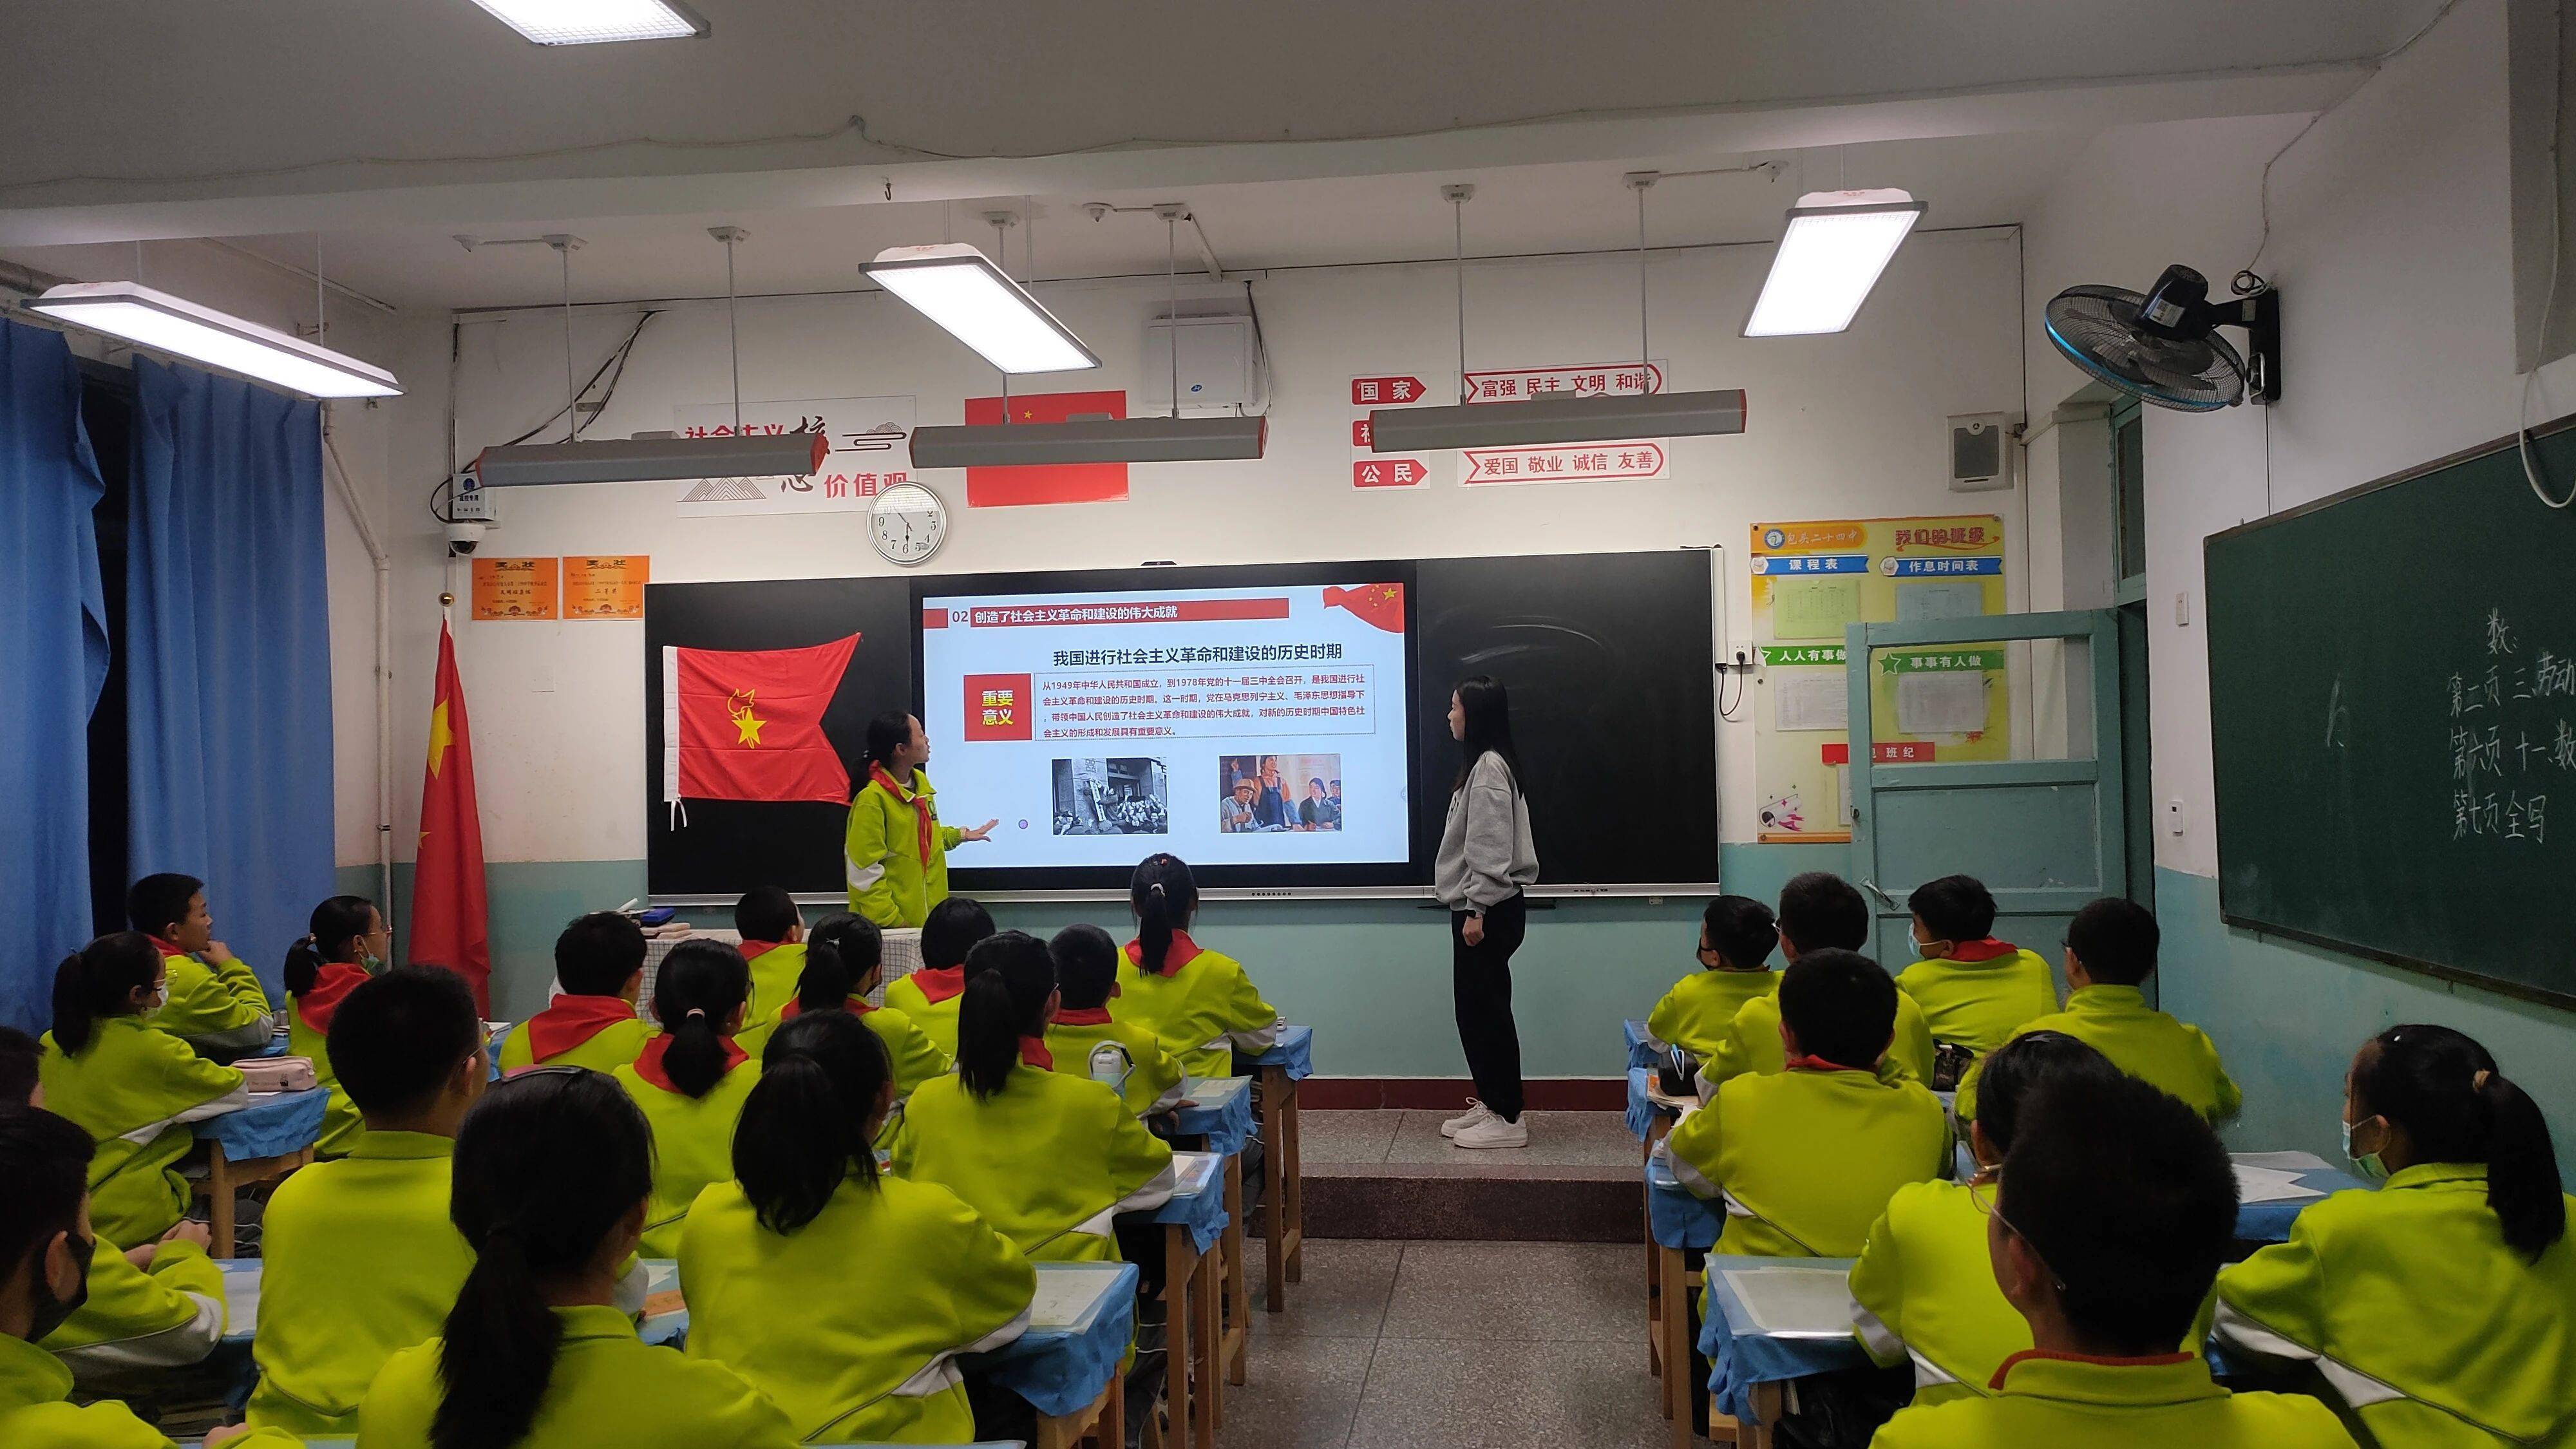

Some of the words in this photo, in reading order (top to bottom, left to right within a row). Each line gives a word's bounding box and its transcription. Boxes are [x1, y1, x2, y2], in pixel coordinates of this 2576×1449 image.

[1361, 381, 1411, 401] 国家
[1481, 379, 1517, 397] 富强
[1526, 377, 1560, 395] 民主
[1571, 374, 1605, 392] 文明
[1484, 457, 1518, 475] 爱国
[1528, 455, 1563, 473] 敬业
[1573, 453, 1608, 471] 诚信
[1618, 451, 1654, 469] 友善
[1361, 463, 1412, 483] 公民
[878, 517, 885, 527] 9
[930, 521, 936, 531] 3
[882, 530, 888, 540] 8
[924, 534, 930, 543] 4
[1787, 529, 1857, 545] 包头二十四中
[1895, 527, 1984, 545] 我们的班级
[891, 540, 897, 549] 7
[902, 544, 909, 554] 6
[915, 542, 922, 552] 5
[1789, 558, 1838, 571] 课程表
[1909, 560, 1978, 573] 作息时间表
[952, 611, 968, 623] 02
[974, 606, 1178, 623] 创造了社会主义革命和建设的伟大成就
[1053, 644, 1341, 666] 我国进行社会主义革命和建设的历史时期
[1779, 649, 1846, 661] 人人有事做
[1910, 655, 1982, 668] 事事有人做
[981, 690, 1014, 706] 重要
[981, 709, 1014, 726] 意义
